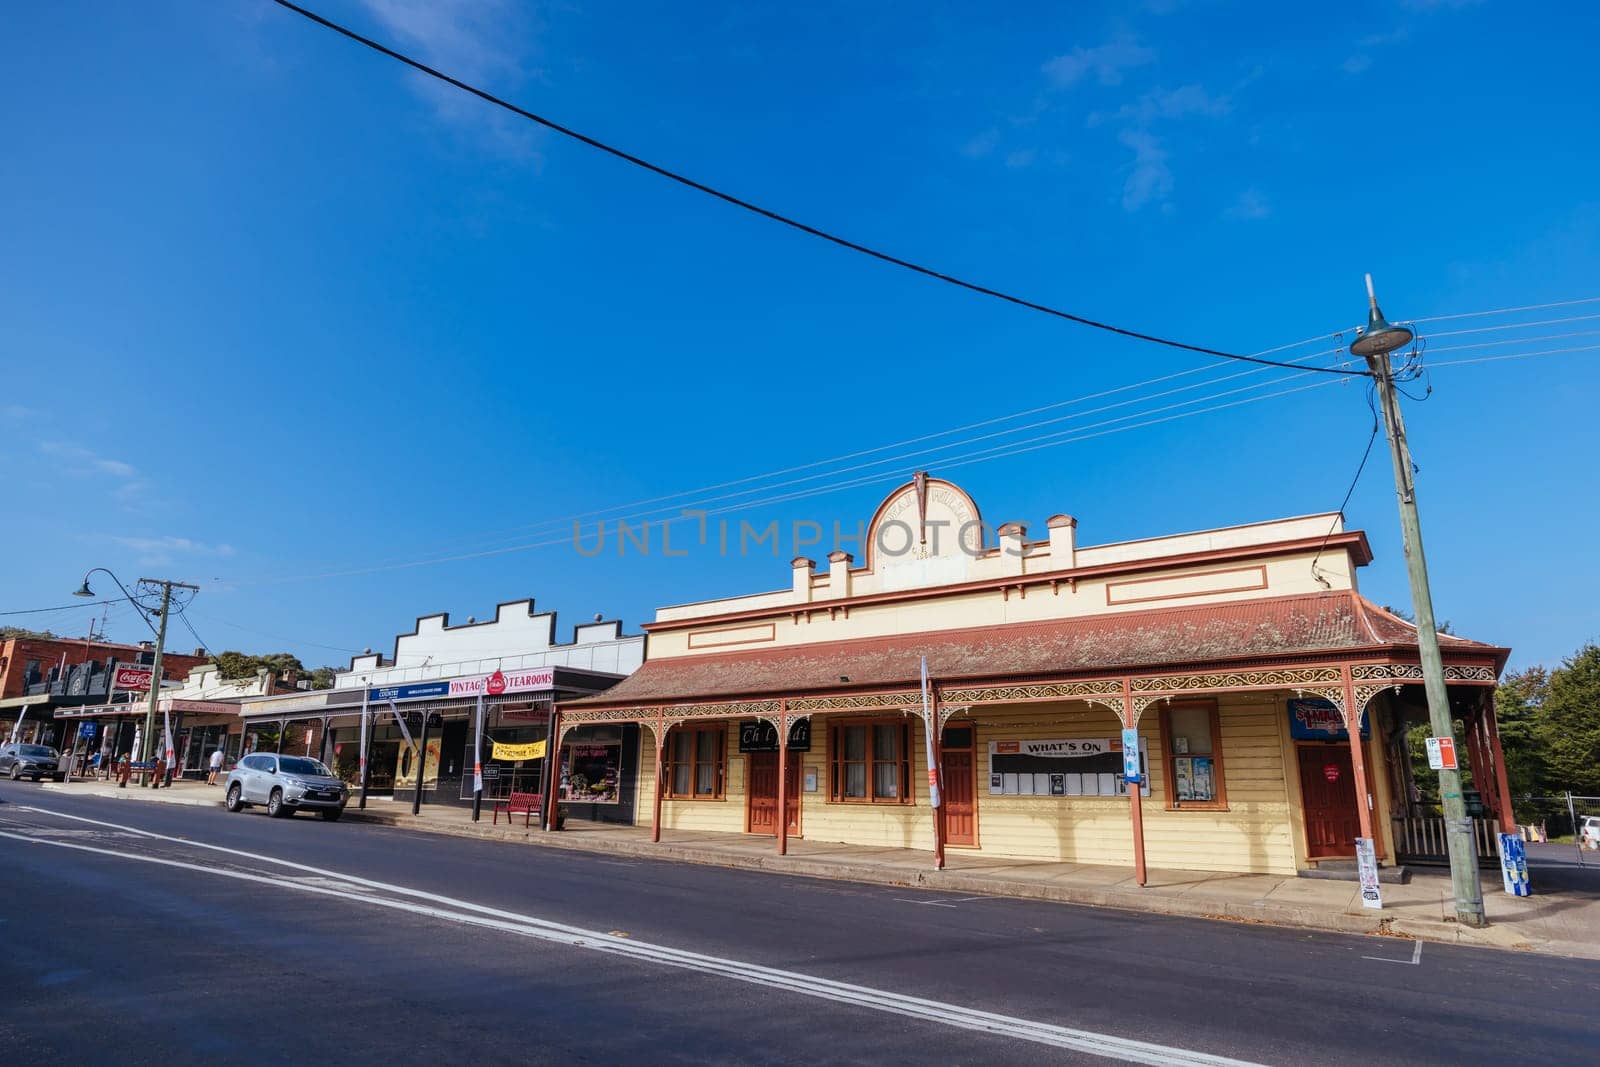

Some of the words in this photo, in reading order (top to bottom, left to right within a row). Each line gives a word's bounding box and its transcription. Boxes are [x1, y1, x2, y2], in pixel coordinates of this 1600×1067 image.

[119, 672, 152, 685] Coca-Col
[509, 673, 552, 687] TEAROOMS
[1028, 742, 1077, 753] WHAT'S
[1082, 742, 1101, 752] ON
